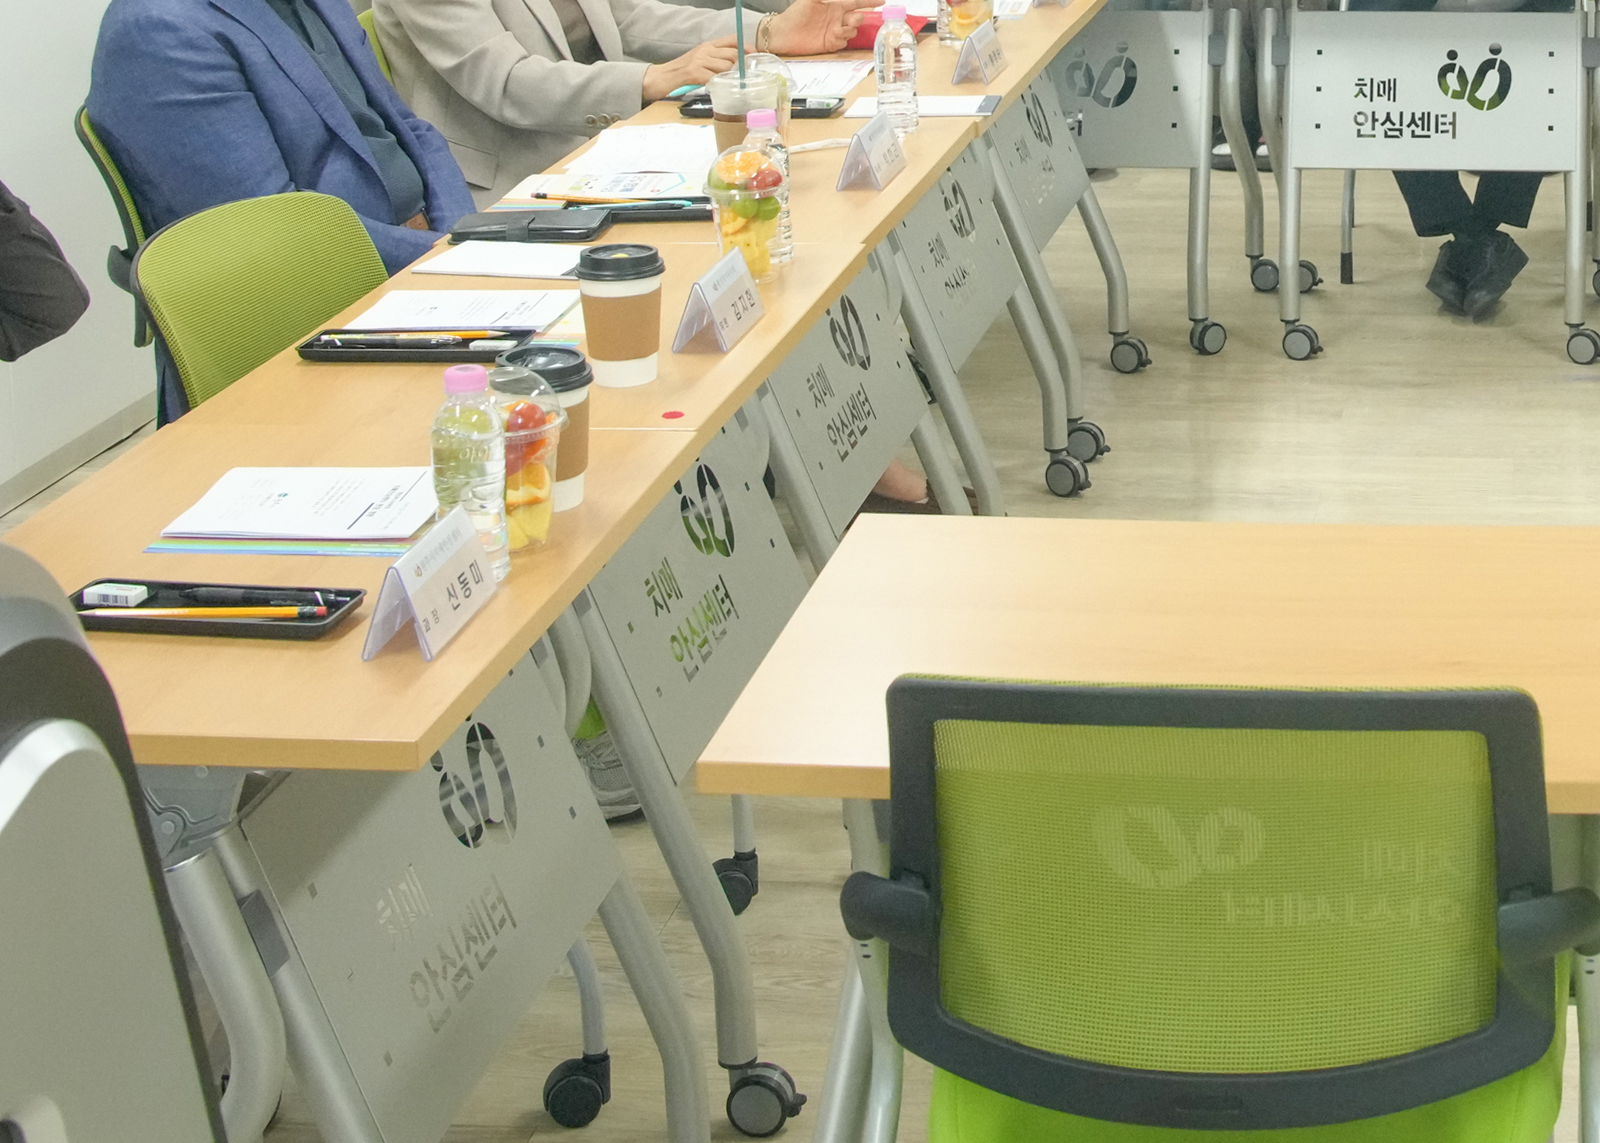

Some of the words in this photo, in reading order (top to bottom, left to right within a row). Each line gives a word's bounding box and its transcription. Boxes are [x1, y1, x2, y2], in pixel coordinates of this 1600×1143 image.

[1354, 78, 1397, 102] 치매
[1353, 111, 1457, 139] 안심센터
[806, 363, 835, 409] 치매
[826, 382, 877, 463] 안심센터
[422, 608, 440, 633] 과장
[446, 559, 485, 611] 신동미
[644, 557, 683, 617] 치매
[670, 574, 740, 683] 안심센터
[409, 872, 517, 1035] 안심센터
